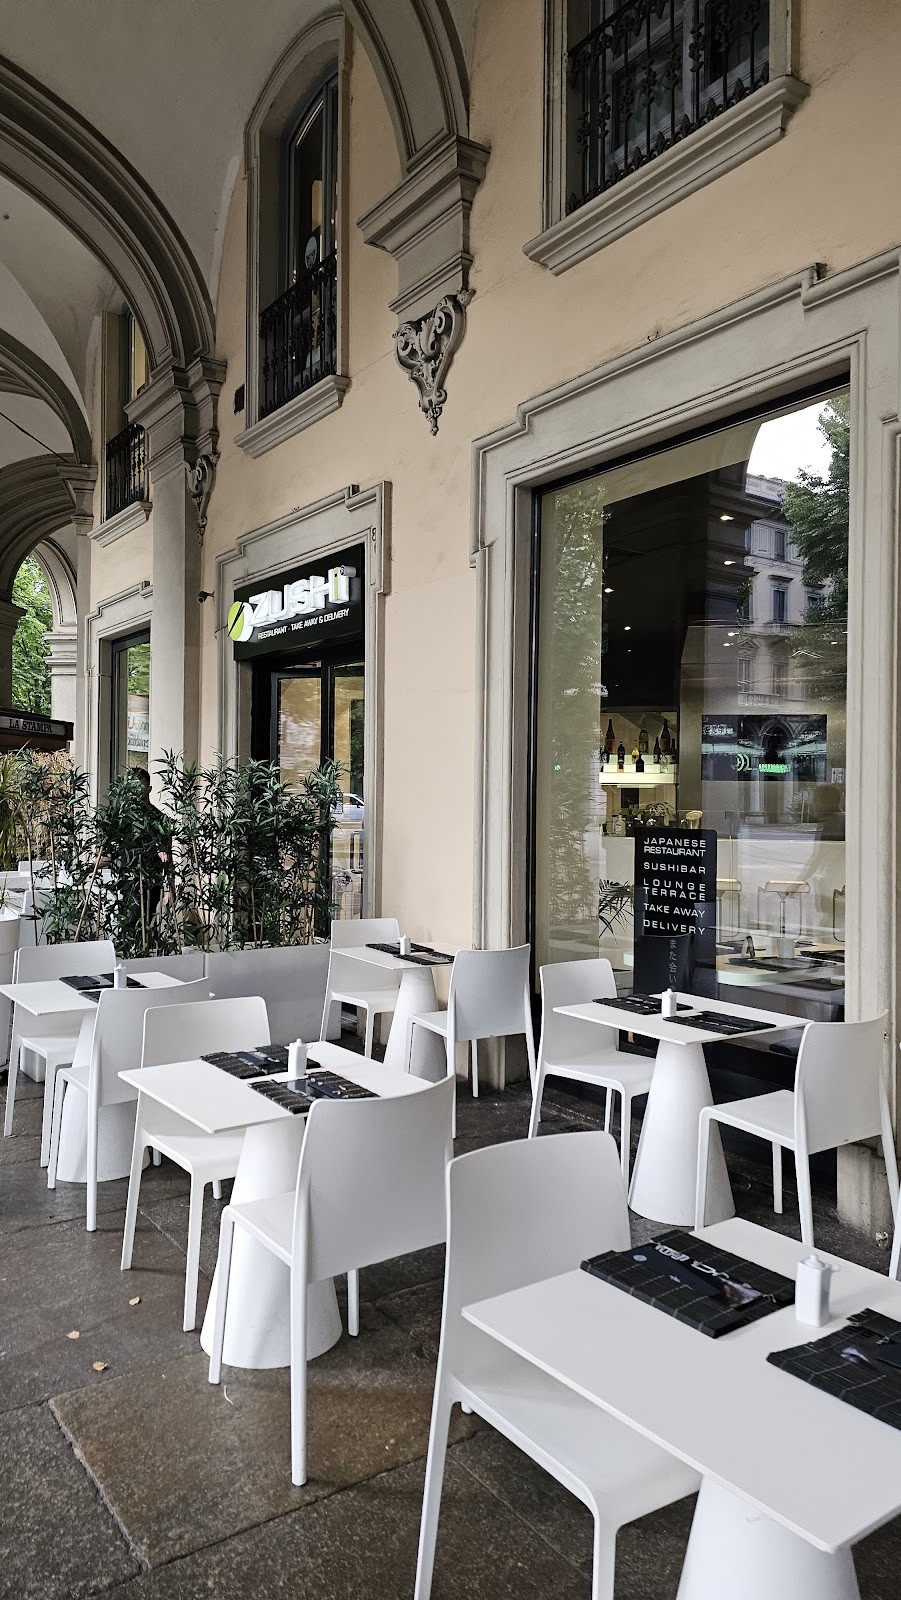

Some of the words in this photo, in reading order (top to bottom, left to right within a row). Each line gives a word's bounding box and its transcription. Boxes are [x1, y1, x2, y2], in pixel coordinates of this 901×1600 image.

[257, 625, 288, 640] RESTAURANT
[290, 621, 304, 631] TAKE
[303, 616, 319, 628] AWAY
[318, 615, 324, 624] &
[324, 608, 350, 622] DELIVERY
[9, 718, 20, 729] LA
[21, 721, 52, 733] STAMPA
[643, 837, 706, 848] JAPANESE
[643, 846, 706, 857] RESTAURANT
[643, 862, 706, 874] SUSHIBAR
[643, 878, 706, 892] LOUNGE
[643, 886, 706, 901] TERRACE
[643, 902, 670, 914] TAKE
[673, 906, 706, 918] AWAY
[643, 919, 706, 935] DELIVERY
